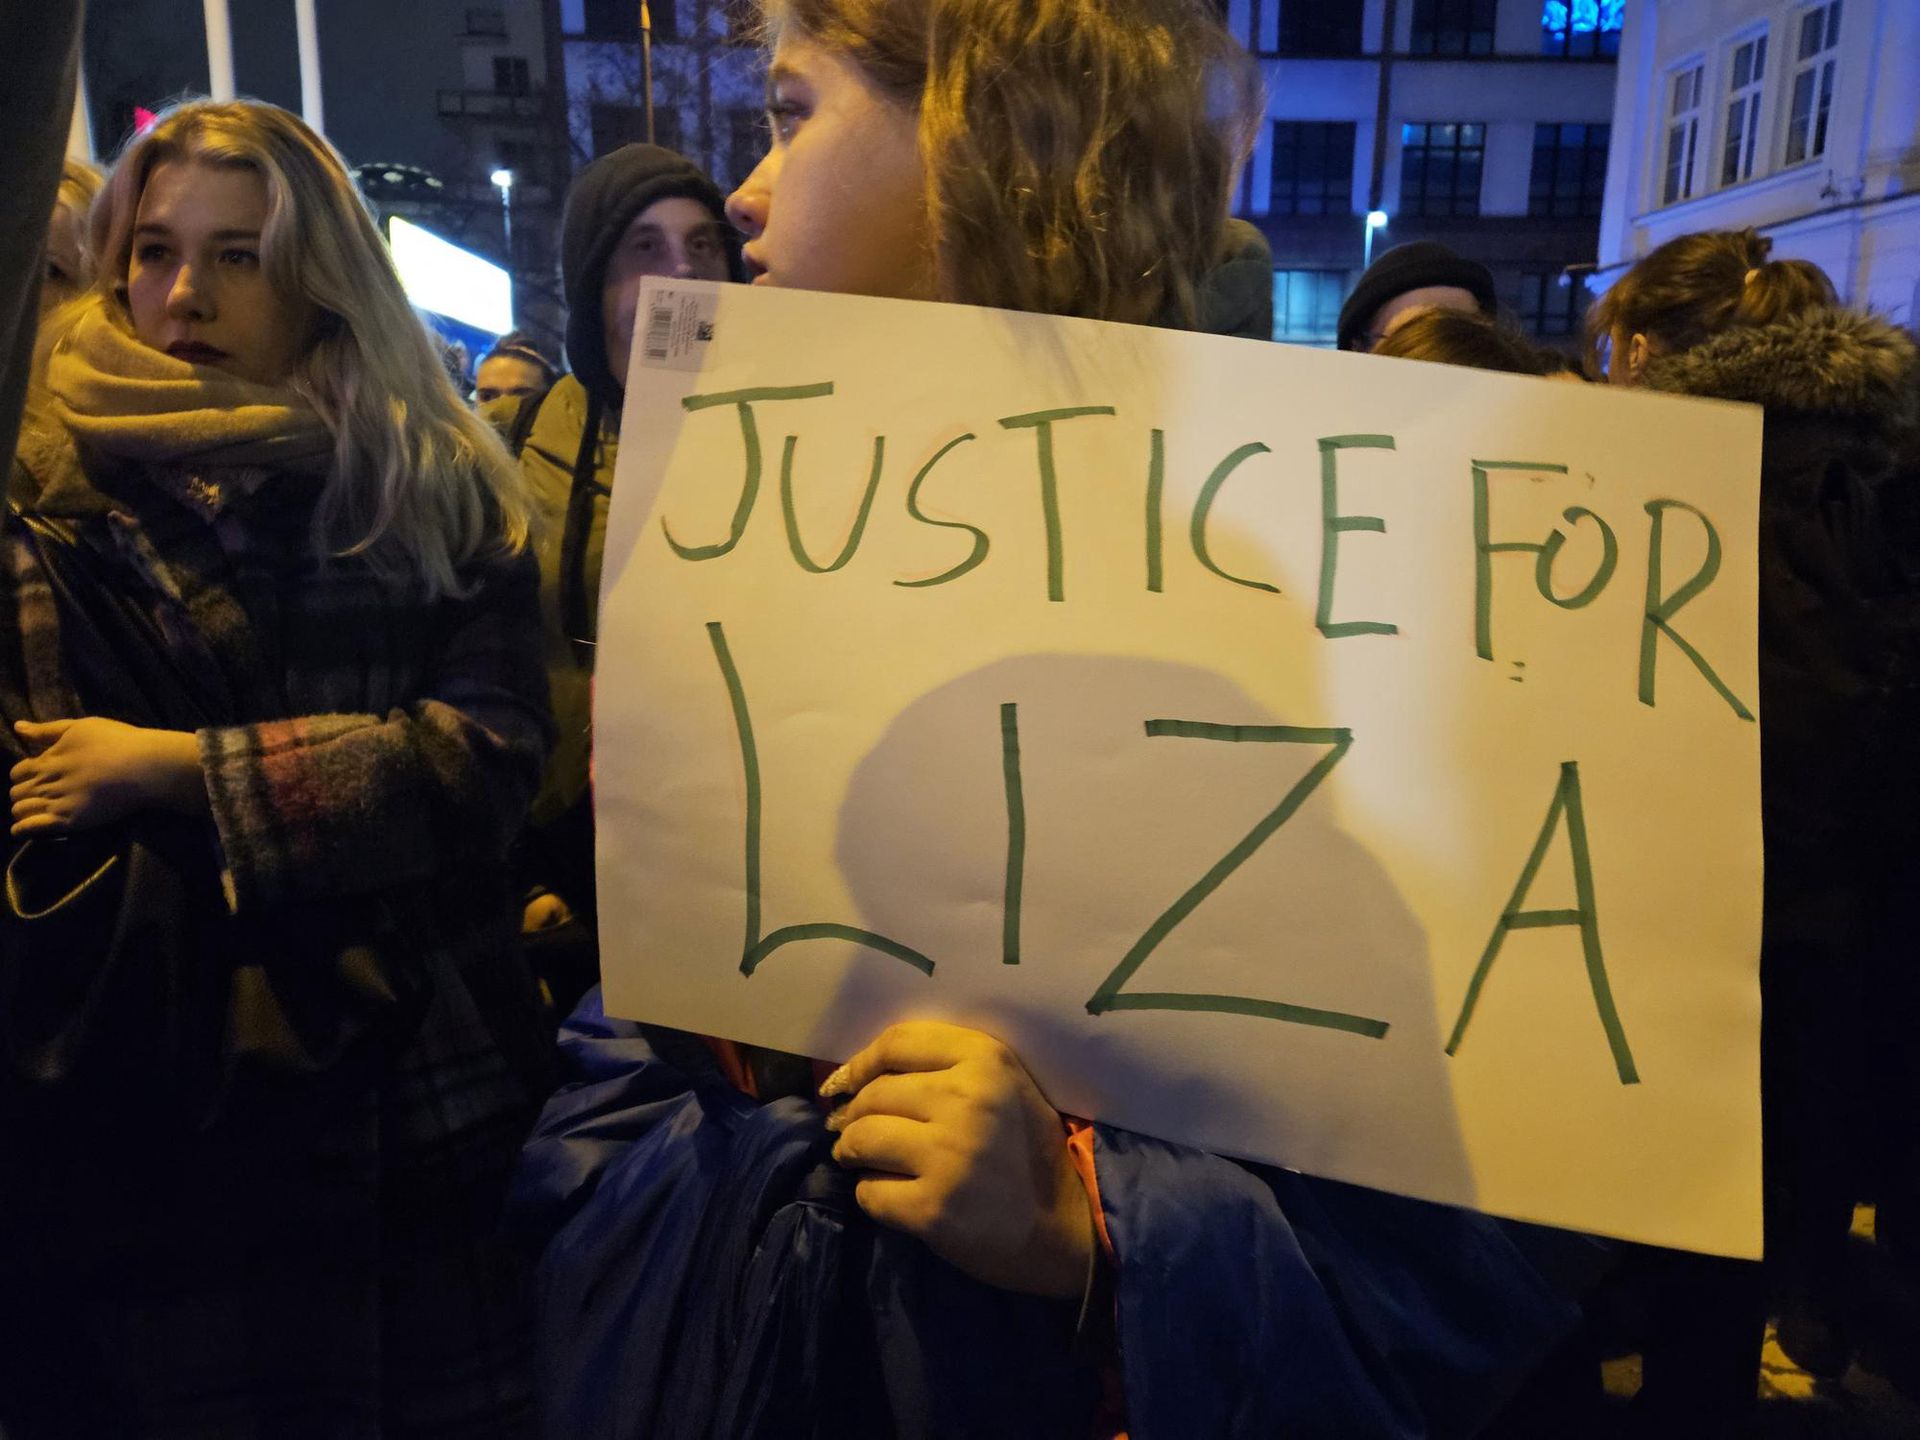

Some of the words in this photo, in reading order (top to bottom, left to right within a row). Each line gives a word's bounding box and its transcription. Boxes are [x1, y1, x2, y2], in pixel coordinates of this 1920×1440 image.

[661, 381, 1399, 639] JUSTICE
[1471, 458, 1757, 723] FOR
[705, 621, 1641, 1085] LIZA
